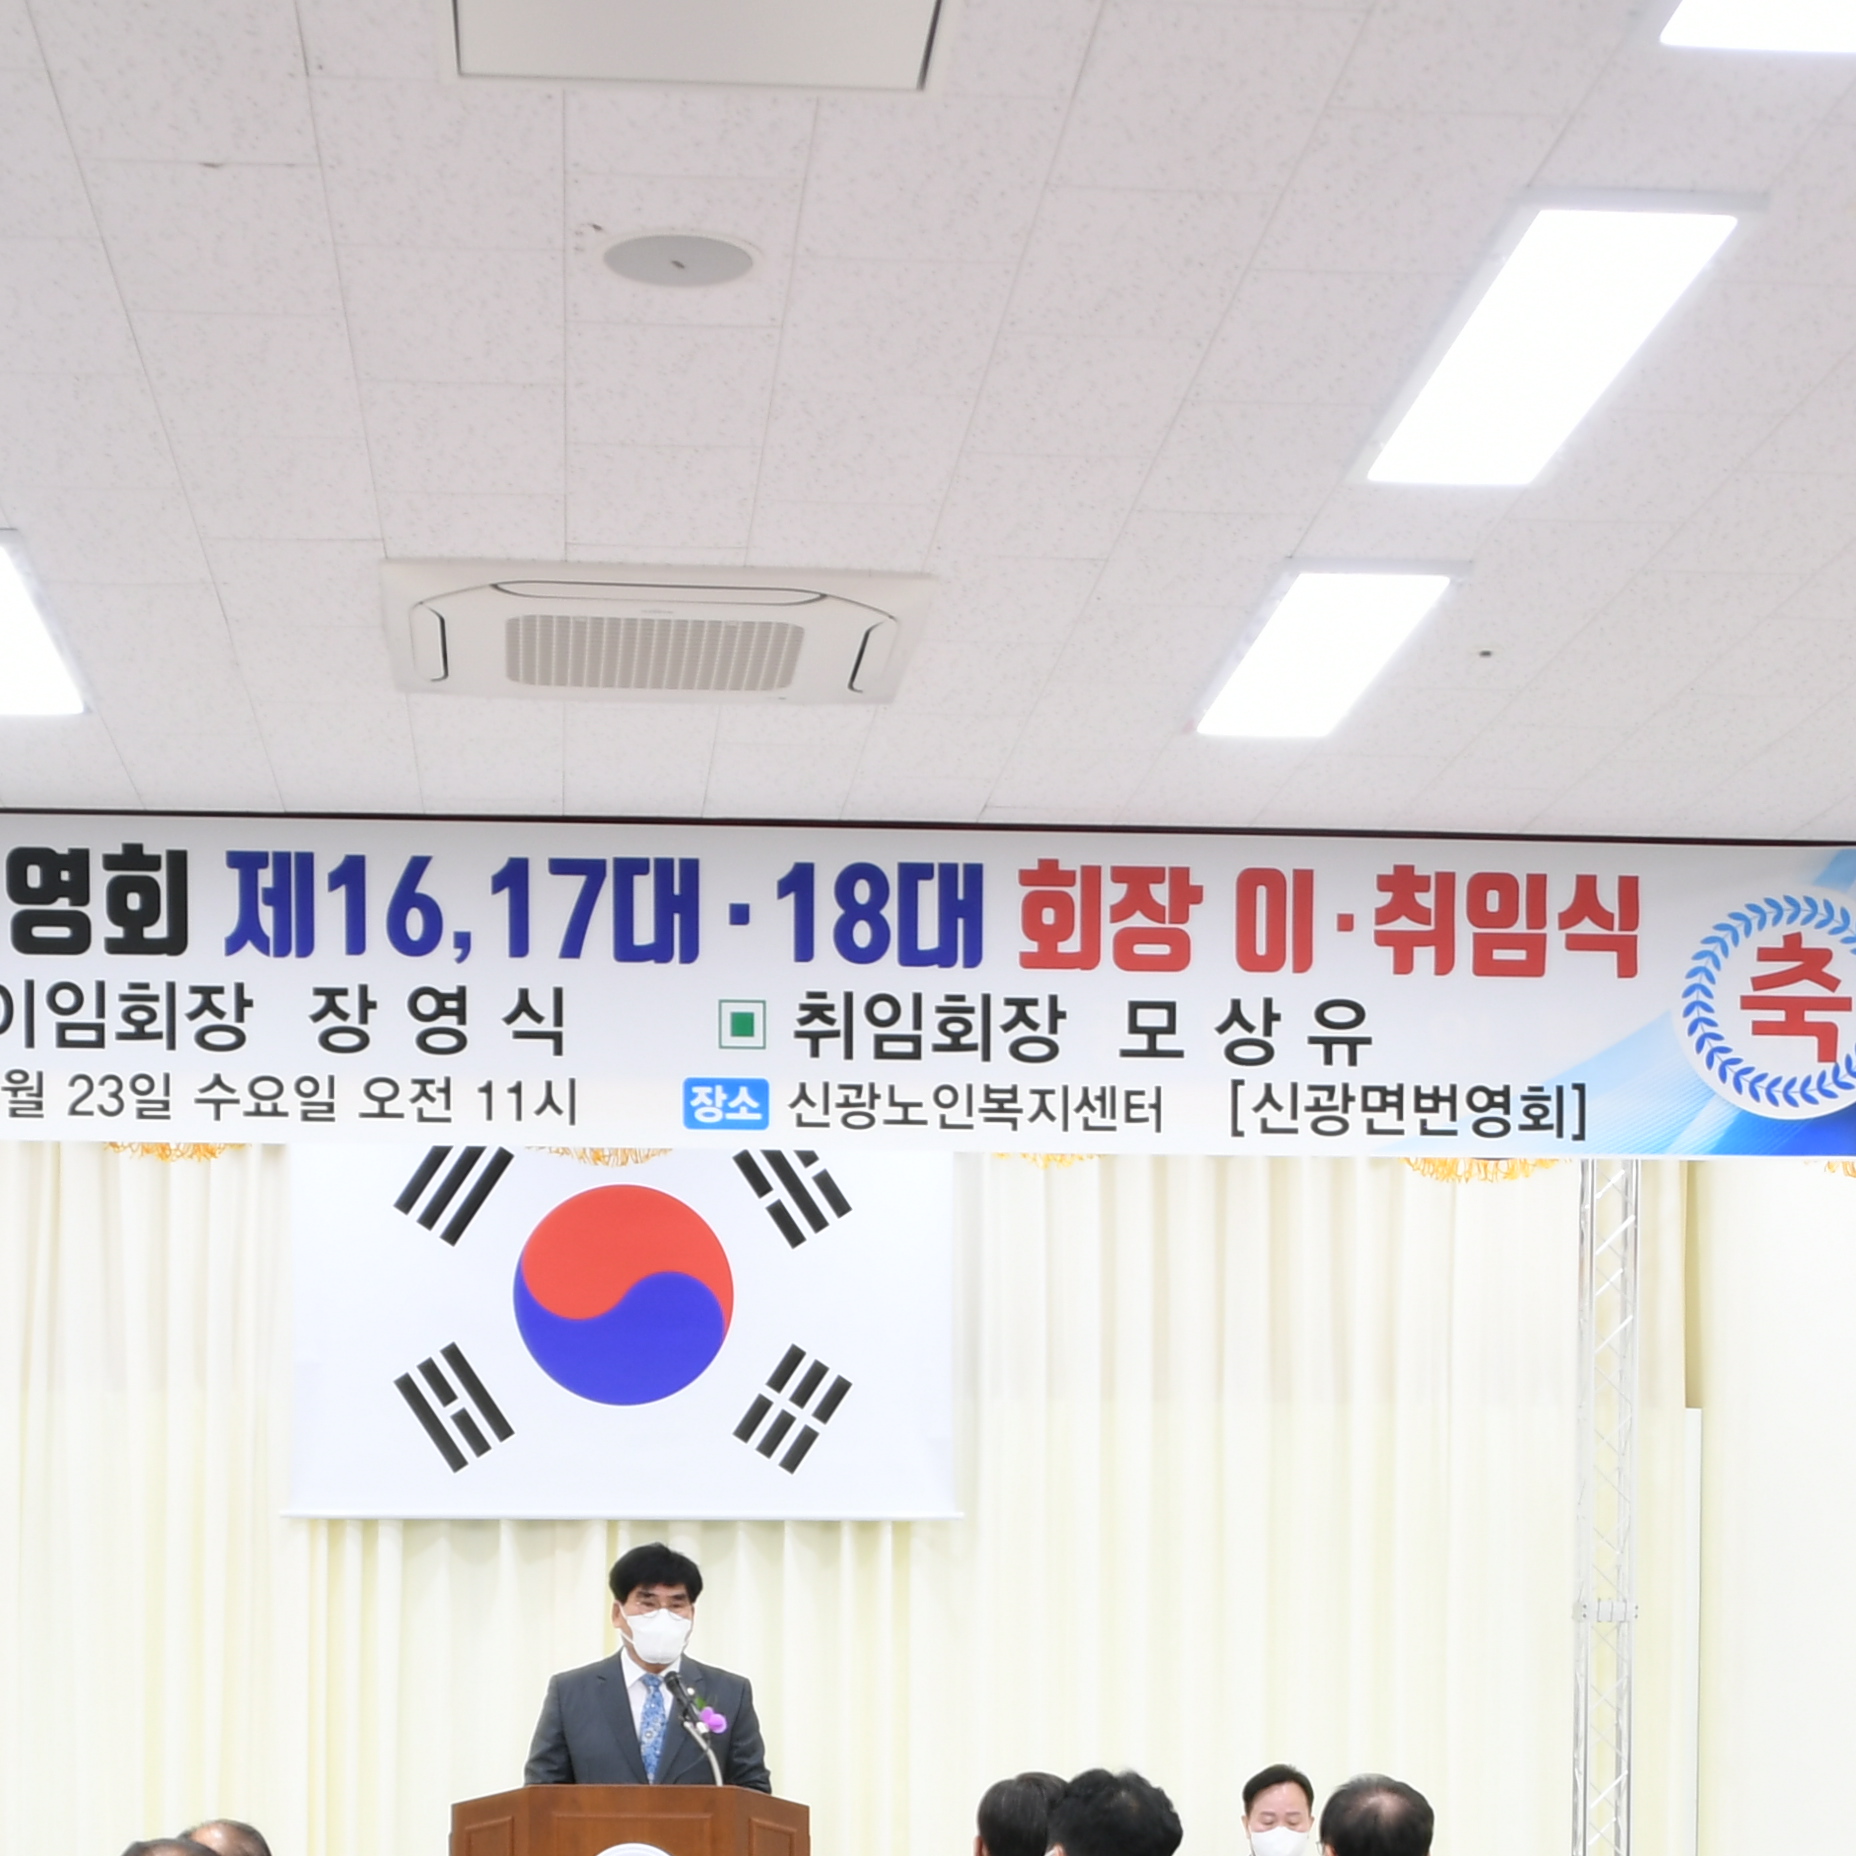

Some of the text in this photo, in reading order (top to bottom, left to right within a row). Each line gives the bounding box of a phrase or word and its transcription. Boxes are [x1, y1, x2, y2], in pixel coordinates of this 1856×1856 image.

[1020, 859, 1203, 972] 회장
[794, 991, 1067, 1064] 취임회장
[1740, 931, 1853, 1064] 축
[68, 1072, 171, 1120] 23일
[195, 1073, 336, 1122] 수요일
[359, 1076, 452, 1123] 오전
[478, 1077, 576, 1126] 11시
[690, 1084, 763, 1124] 장소
[788, 1078, 1586, 1142] 신광노인복지센터 [신광면번영회]
